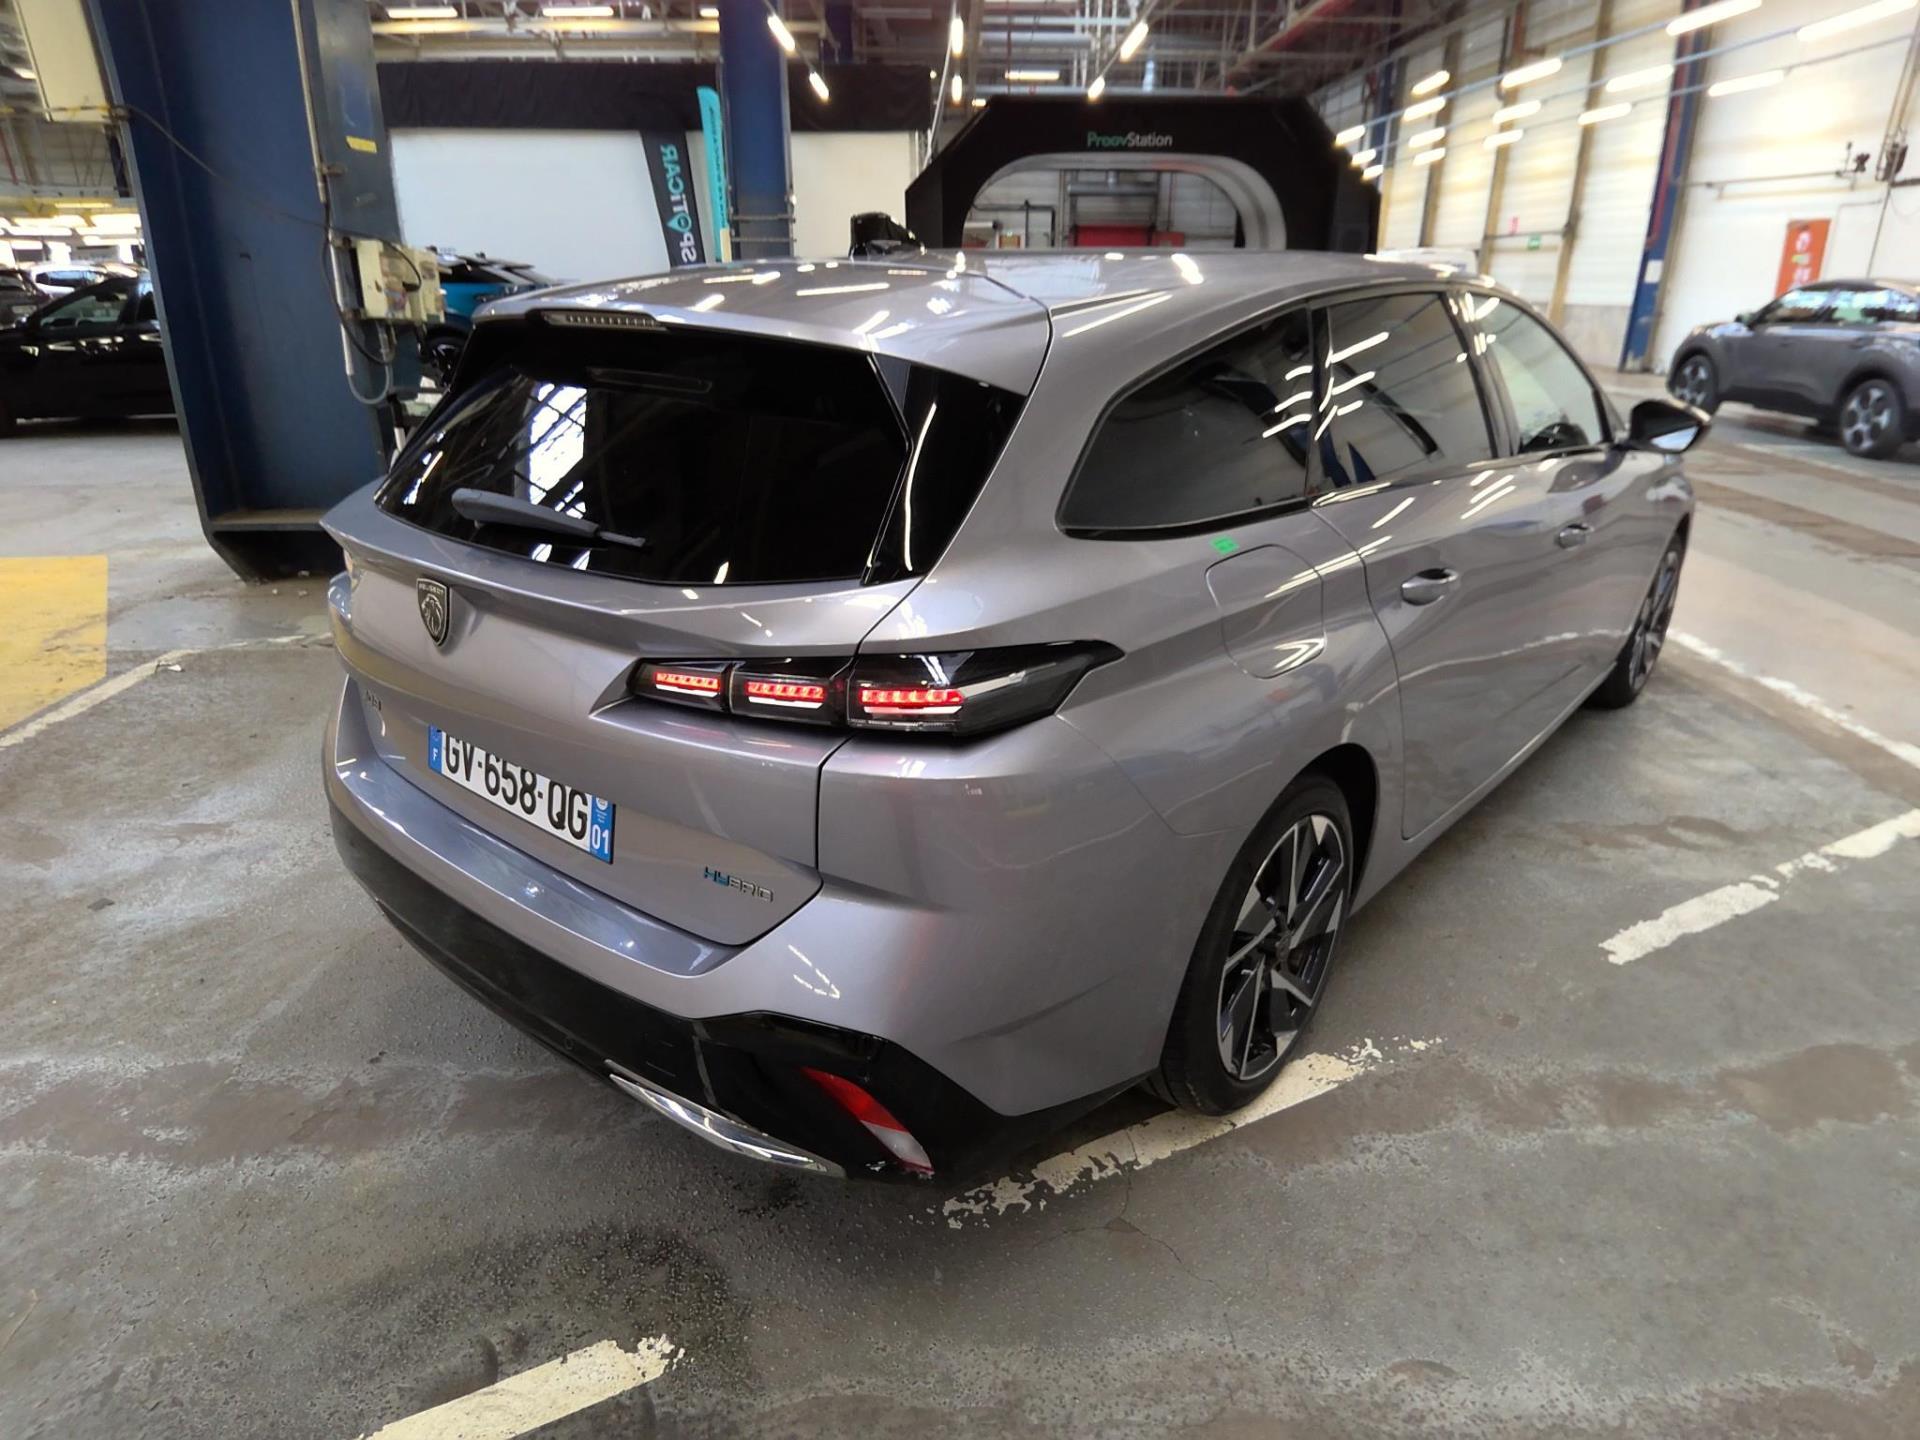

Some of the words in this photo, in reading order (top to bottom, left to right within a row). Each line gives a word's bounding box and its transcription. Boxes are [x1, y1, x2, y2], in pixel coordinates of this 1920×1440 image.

[1086, 131, 1173, 148] ProovStation
[432, 747, 439, 761] F
[445, 734, 589, 841] GV-658-QG
[591, 823, 609, 855] 01
[704, 866, 774, 902] HYBRID
